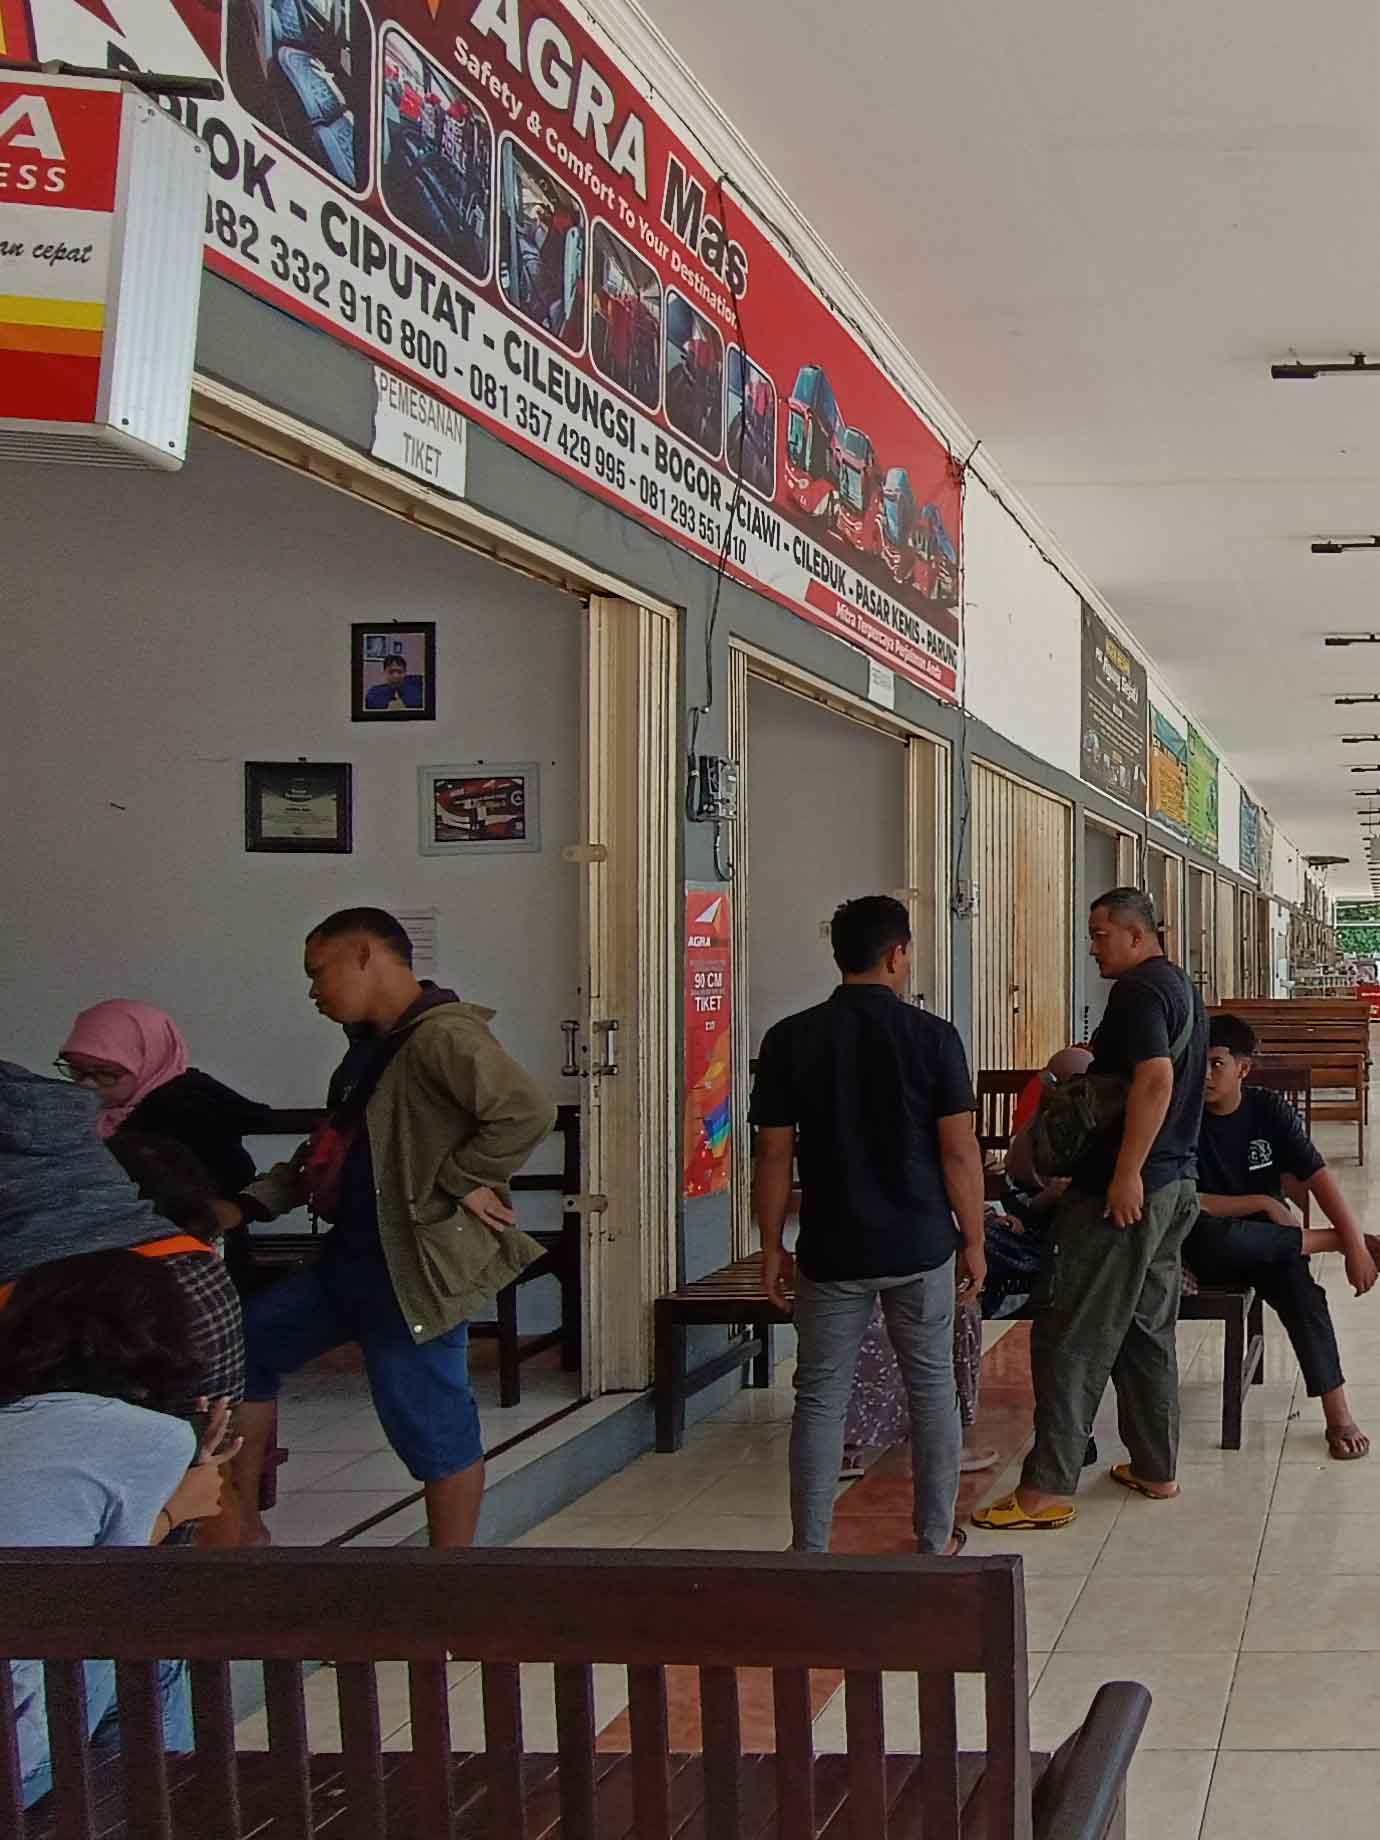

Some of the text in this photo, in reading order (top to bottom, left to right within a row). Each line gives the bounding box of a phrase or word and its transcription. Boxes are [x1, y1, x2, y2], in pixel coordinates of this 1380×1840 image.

[470, 0, 749, 300] AGRA Mas
[454, 36, 737, 330] Safety & Comfort To Your Destination
[32, 242, 93, 267] cepat
[270, 239, 330, 309] 332
[339, 281, 393, 346] 916
[400, 318, 448, 379] 800
[470, 363, 509, 418] 081
[516, 394, 552, 442] 357
[557, 423, 590, 468] 429
[595, 445, 625, 490] 995
[640, 474, 665, 515] 081
[671, 494, 695, 533] 293
[699, 511, 720, 549] 551
[320, 201, 476, 342] CIPUTAT
[503, 330, 635, 453] CILEUNGSI
[655, 435, 722, 511] BOGOR
[736, 495, 781, 552] CIAWI
[793, 536, 847, 596] CILEDUK
[856, 579, 890, 625] PASAR
[892, 601, 920, 644] KEMIS
[380, 371, 463, 445] PEMESANAN
[403, 431, 443, 478] TIKET
[687, 935, 712, 948] AGRA
[694, 972, 723, 989] 90 CM
[694, 995, 722, 1012] TIKET
